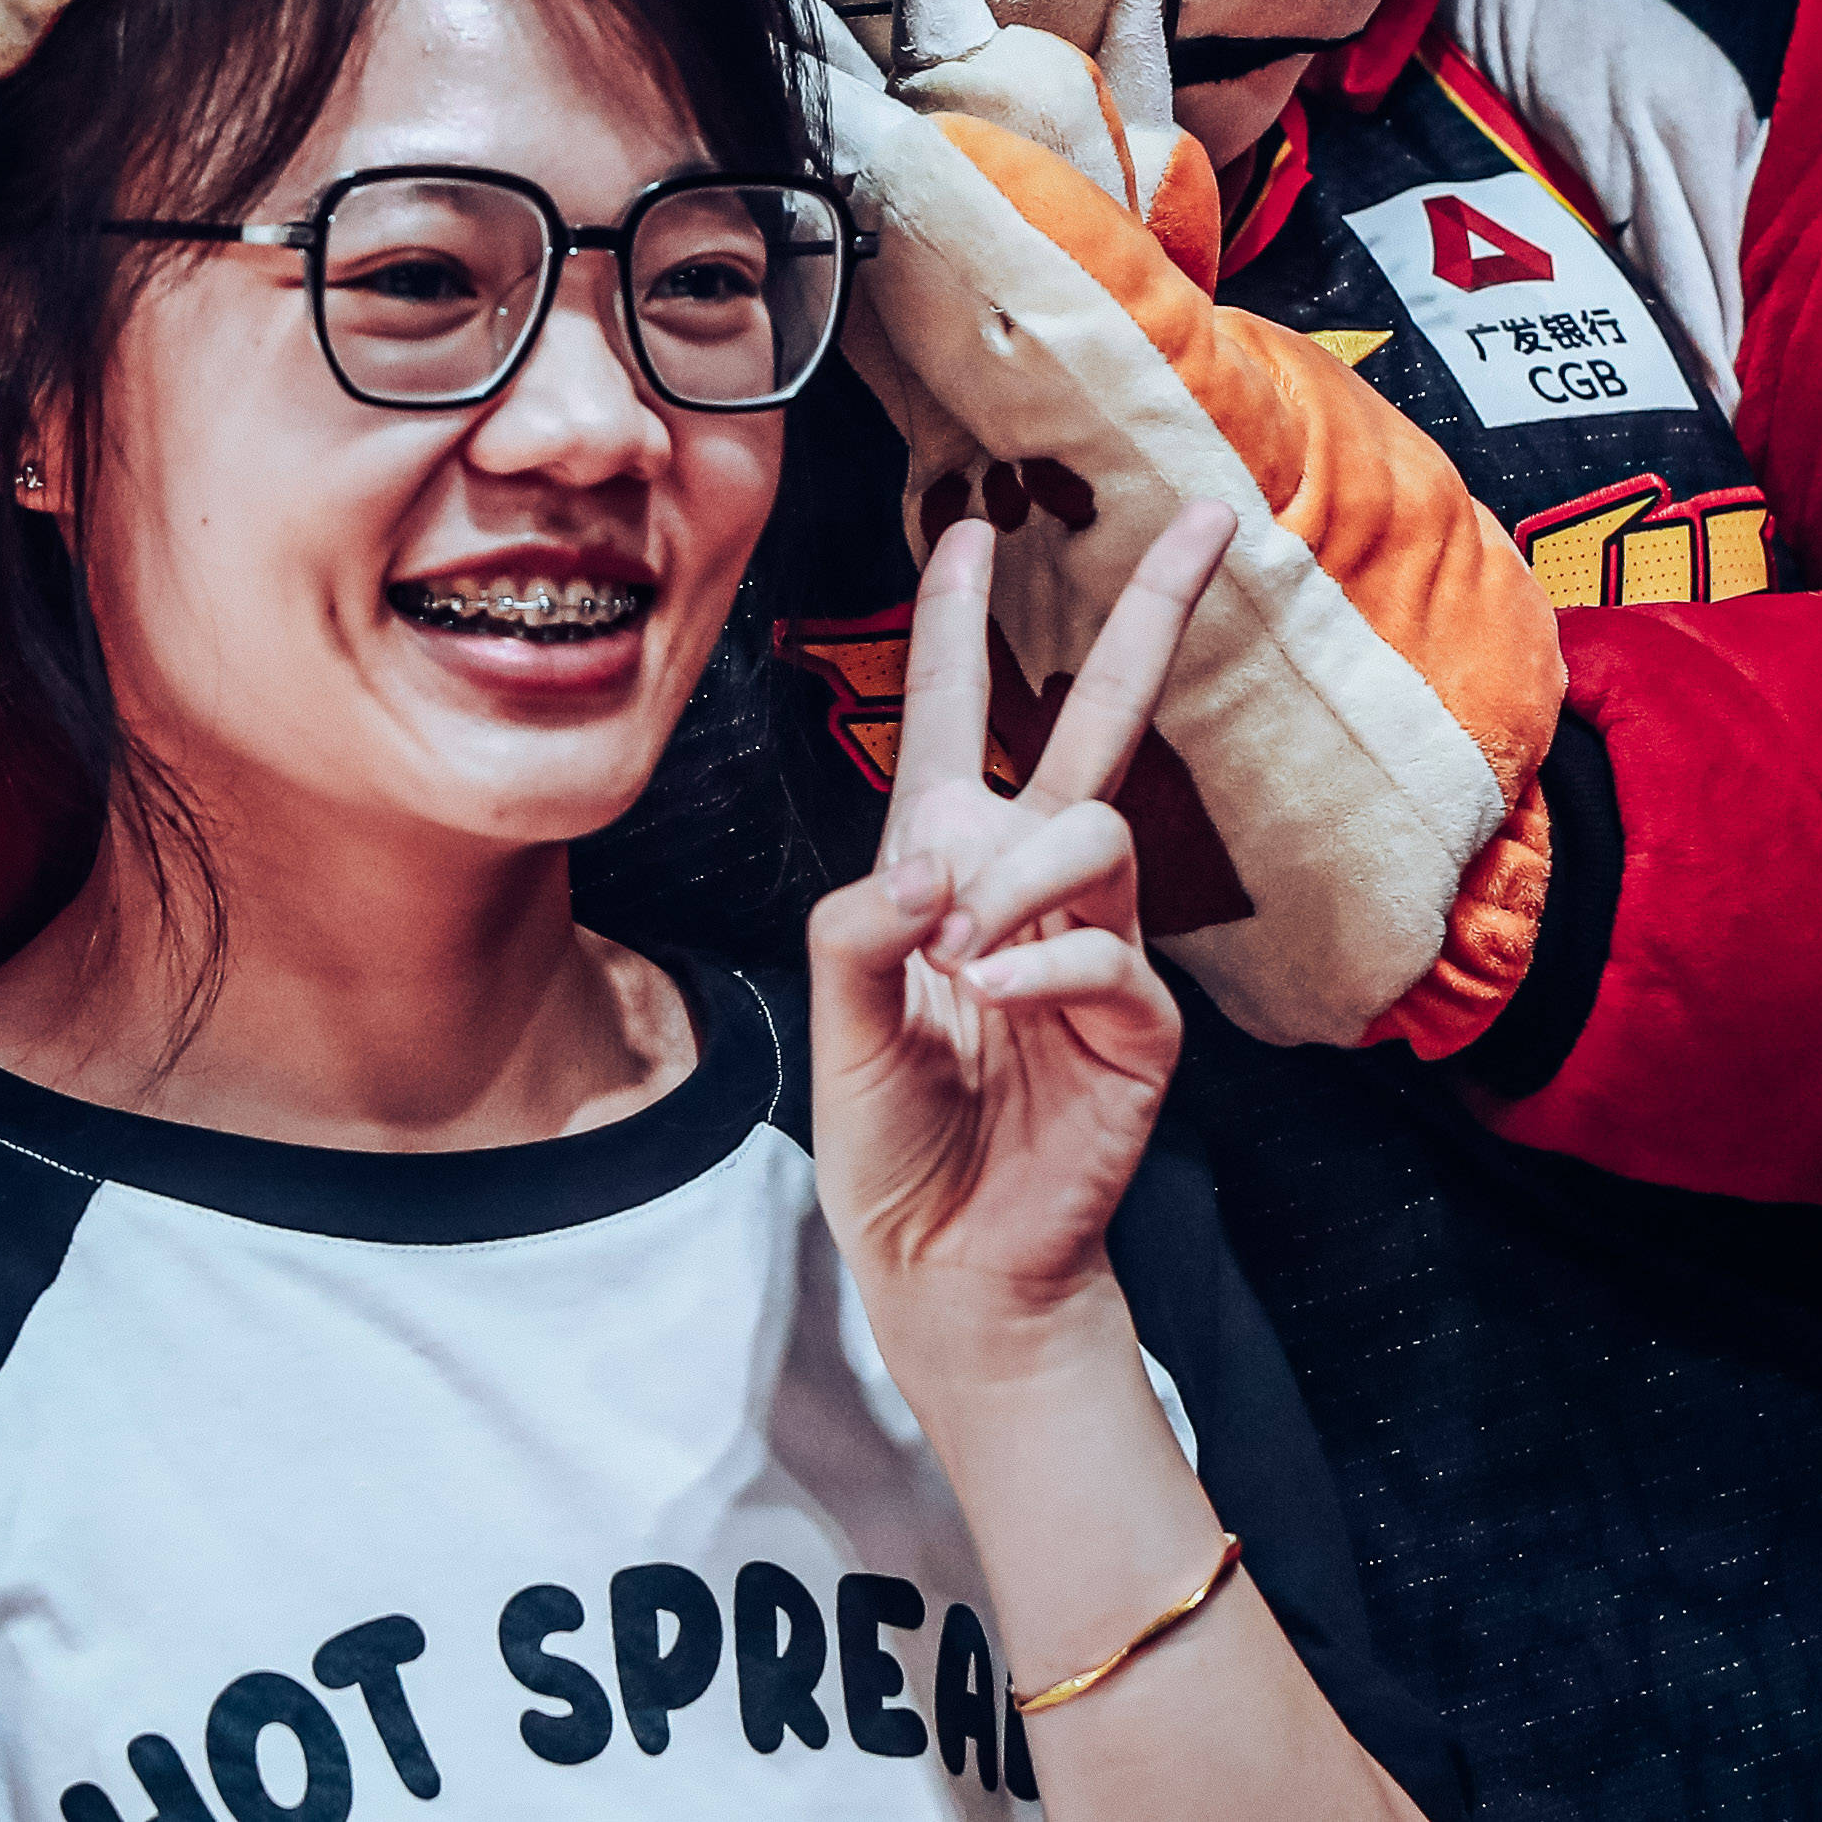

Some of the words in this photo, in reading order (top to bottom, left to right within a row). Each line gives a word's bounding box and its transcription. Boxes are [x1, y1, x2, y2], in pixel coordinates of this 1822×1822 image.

[1464, 308, 1628, 362] 广发银行
[1528, 359, 1628, 404] CGB
